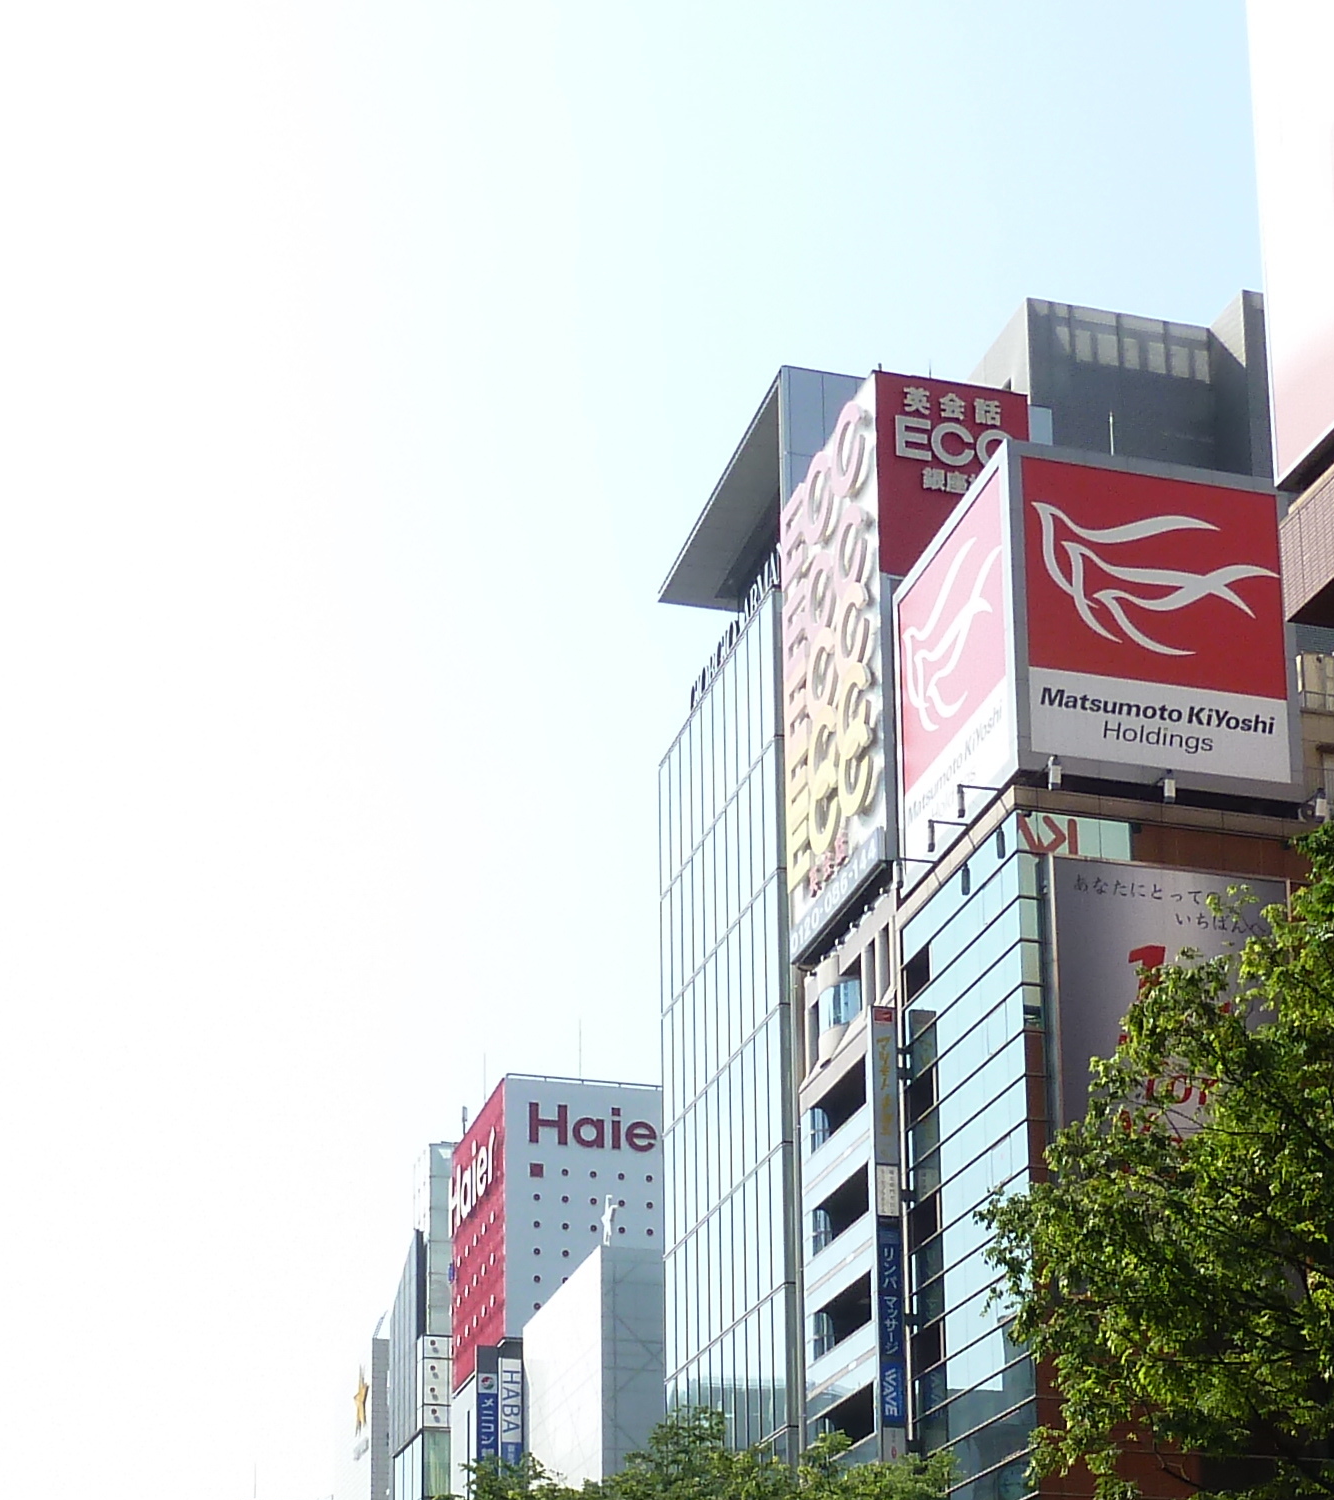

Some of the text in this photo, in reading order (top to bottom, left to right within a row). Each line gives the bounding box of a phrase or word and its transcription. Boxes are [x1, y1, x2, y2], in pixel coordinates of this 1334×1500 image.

[904, 386, 1001, 427] 英会話
[922, 466, 979, 495] 銀座
[1040, 687, 1275, 735] Matsumoto KiYoshi
[1103, 720, 1213, 755] Holdings
[448, 1126, 496, 1238] Haier
[502, 1370, 521, 1433] HABA
[882, 1368, 898, 1417] WAVE
